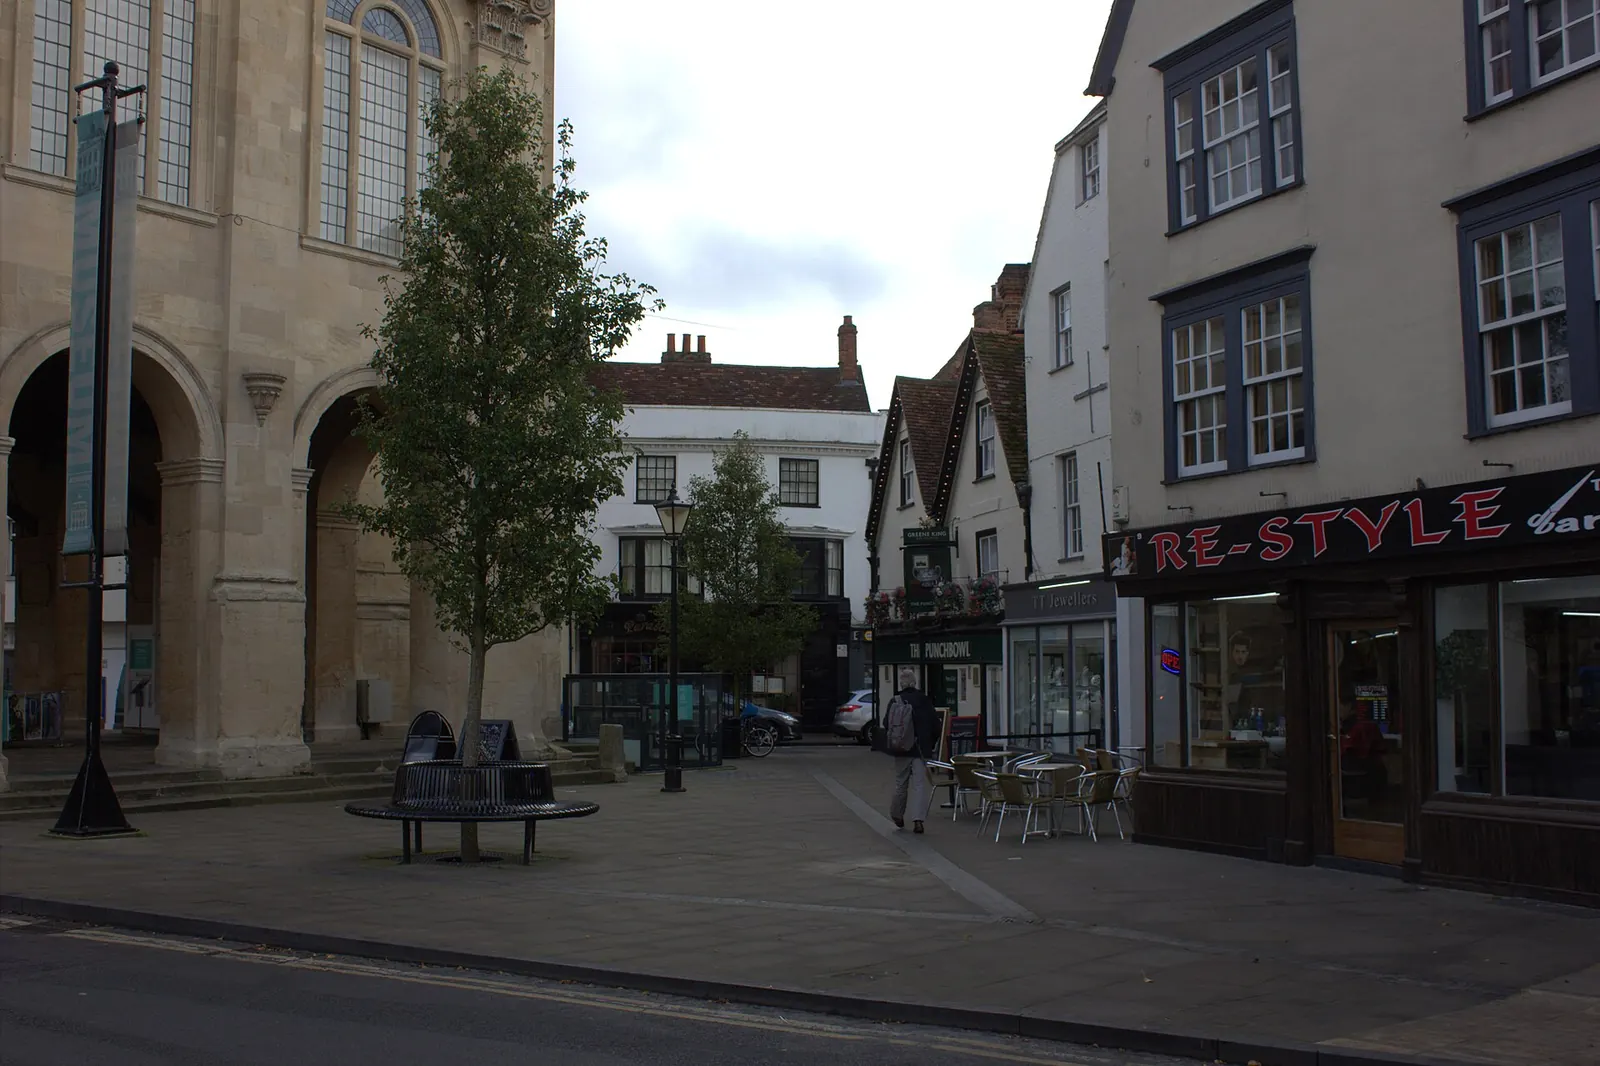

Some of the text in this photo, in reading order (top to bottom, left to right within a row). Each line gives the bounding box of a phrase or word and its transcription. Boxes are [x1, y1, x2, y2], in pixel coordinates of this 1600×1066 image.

[67, 201, 99, 466] MUSEUM
[1147, 485, 1512, 574] RE-STYLE
[1049, 592, 1097, 608] Jewellers
[925, 641, 971, 659] PUNCHBOWL
